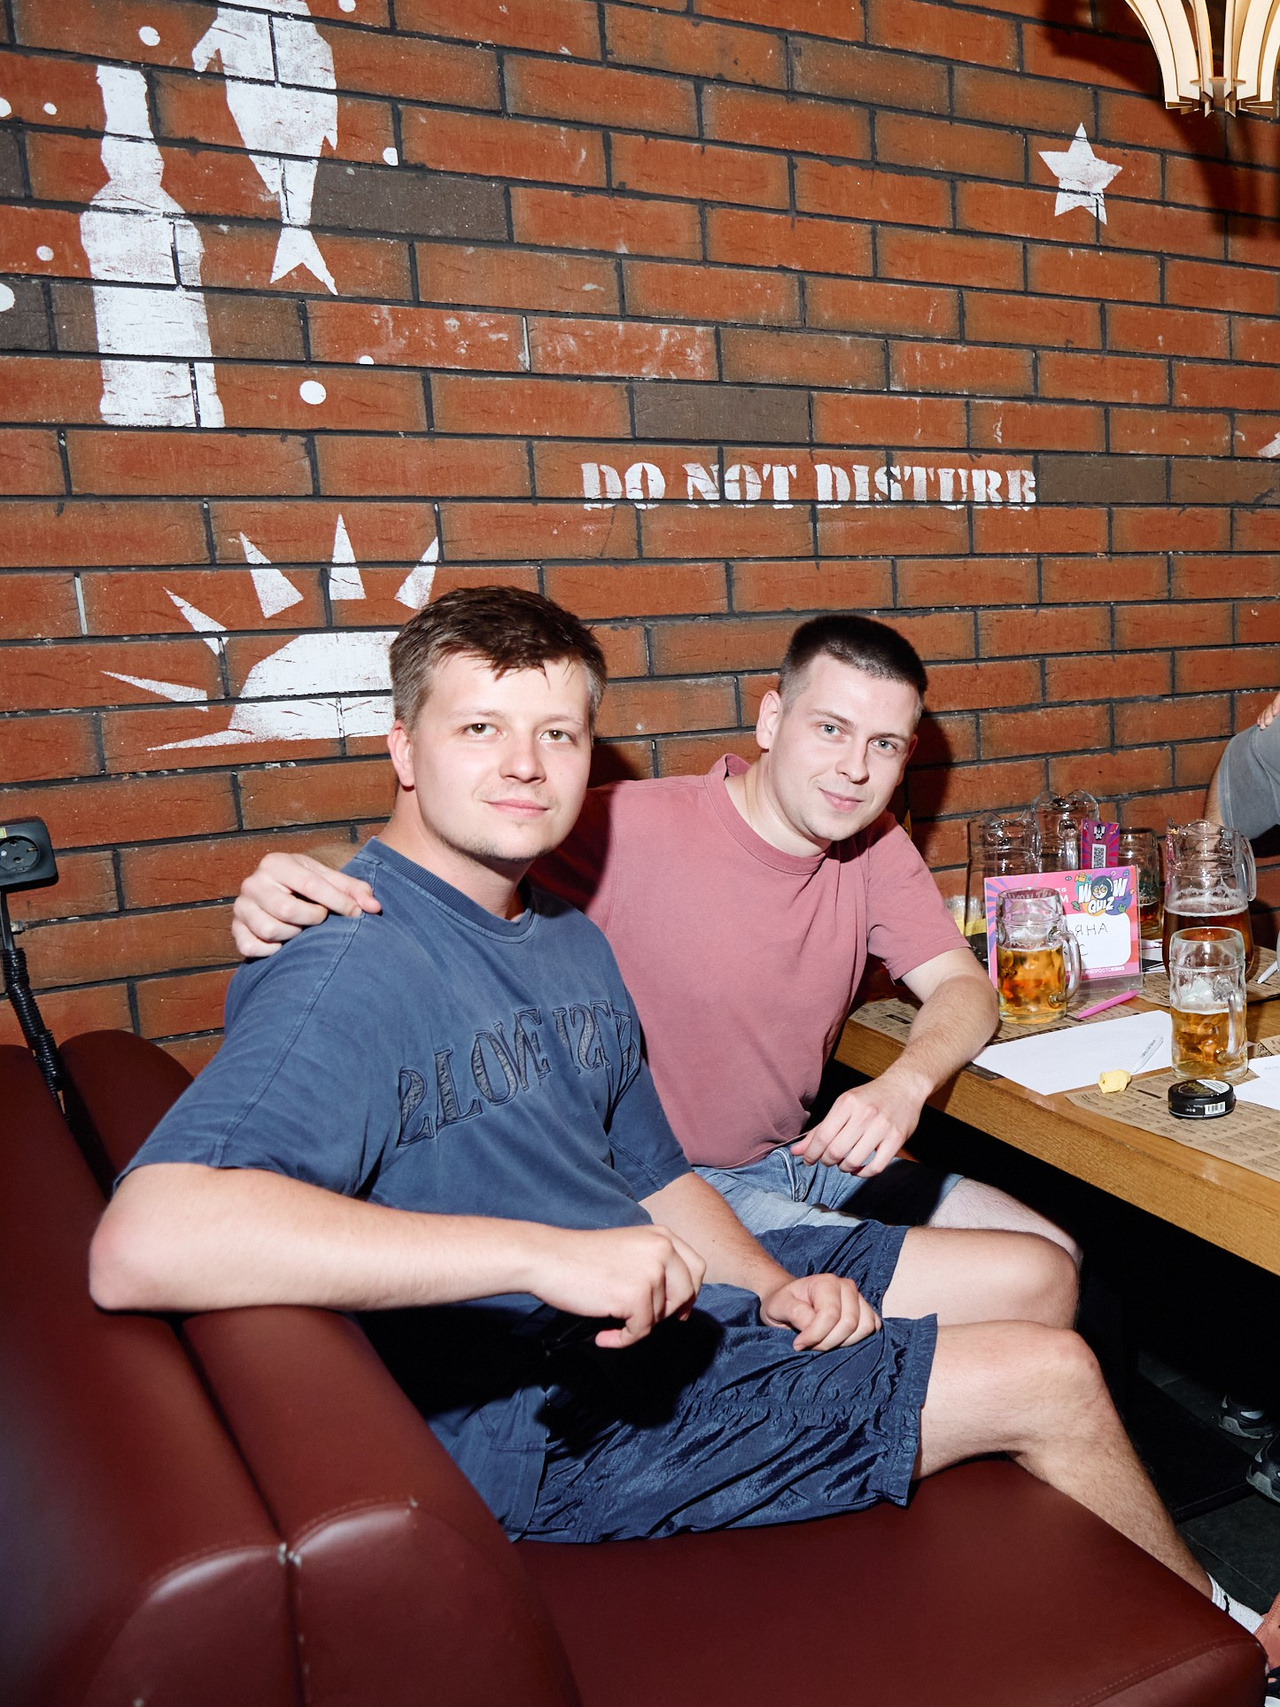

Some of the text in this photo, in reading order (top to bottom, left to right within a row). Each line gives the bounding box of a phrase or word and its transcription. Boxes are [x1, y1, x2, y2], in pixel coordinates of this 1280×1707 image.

[580, 462, 1037, 512] DO NOT DISTURB
[1088, 896, 1115, 914] QUIZ
